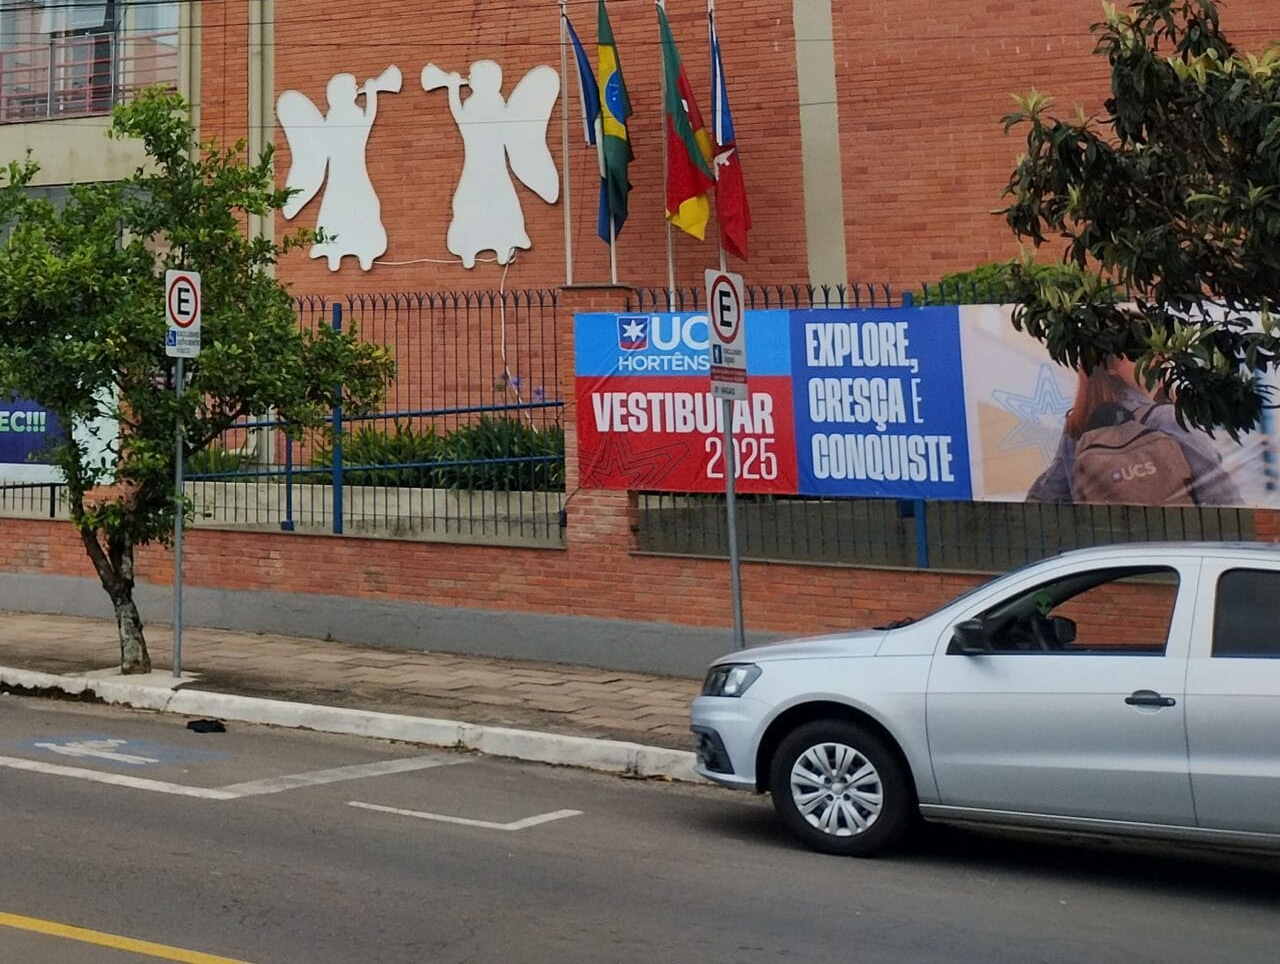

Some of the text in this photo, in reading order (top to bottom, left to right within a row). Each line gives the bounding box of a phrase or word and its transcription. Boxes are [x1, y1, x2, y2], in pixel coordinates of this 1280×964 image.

[177, 287, 190, 316] E
[718, 289, 732, 328] E
[651, 315, 710, 350] UC
[805, 322, 918, 373] EXPLORE,
[619, 351, 710, 371] HORTÊNS
[808, 377, 924, 431] CRESÇA E
[812, 433, 954, 483] CONQUISTE
[1121, 462, 1156, 480] UCS
